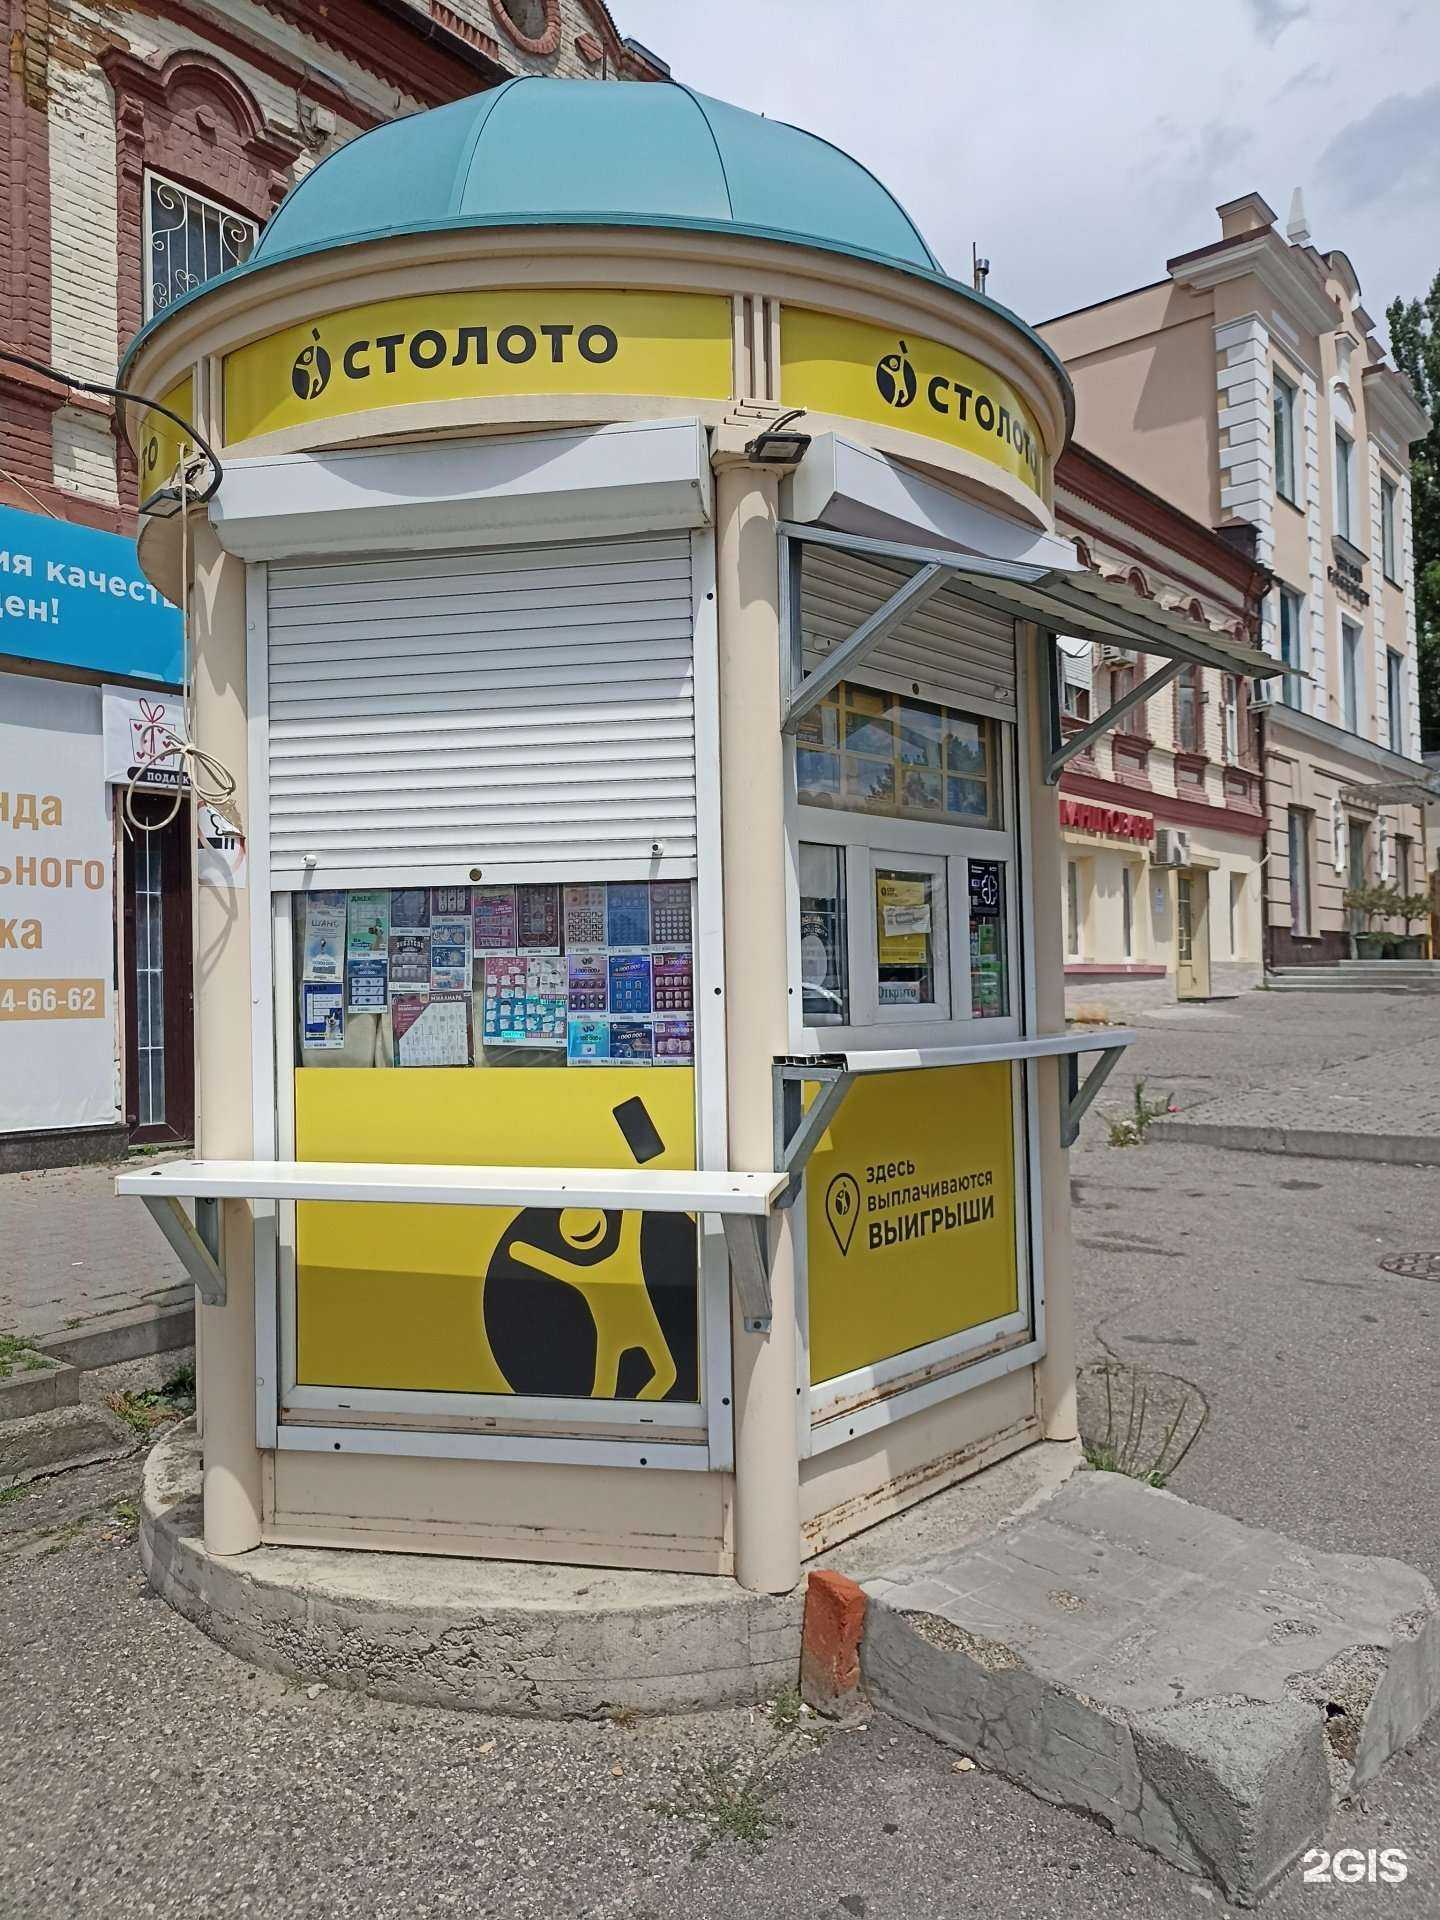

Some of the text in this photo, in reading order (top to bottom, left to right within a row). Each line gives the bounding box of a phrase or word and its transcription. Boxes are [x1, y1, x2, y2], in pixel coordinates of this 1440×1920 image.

[343, 324, 618, 379] СТОЛОТО
[928, 376, 1037, 476] СТОЛОТО
[0, 595, 58, 625] ен!
[866, 1160, 915, 1184] здесь
[867, 1171, 993, 1212] выплачиваются
[869, 1195, 994, 1249] ВЫИГРЫШИ
